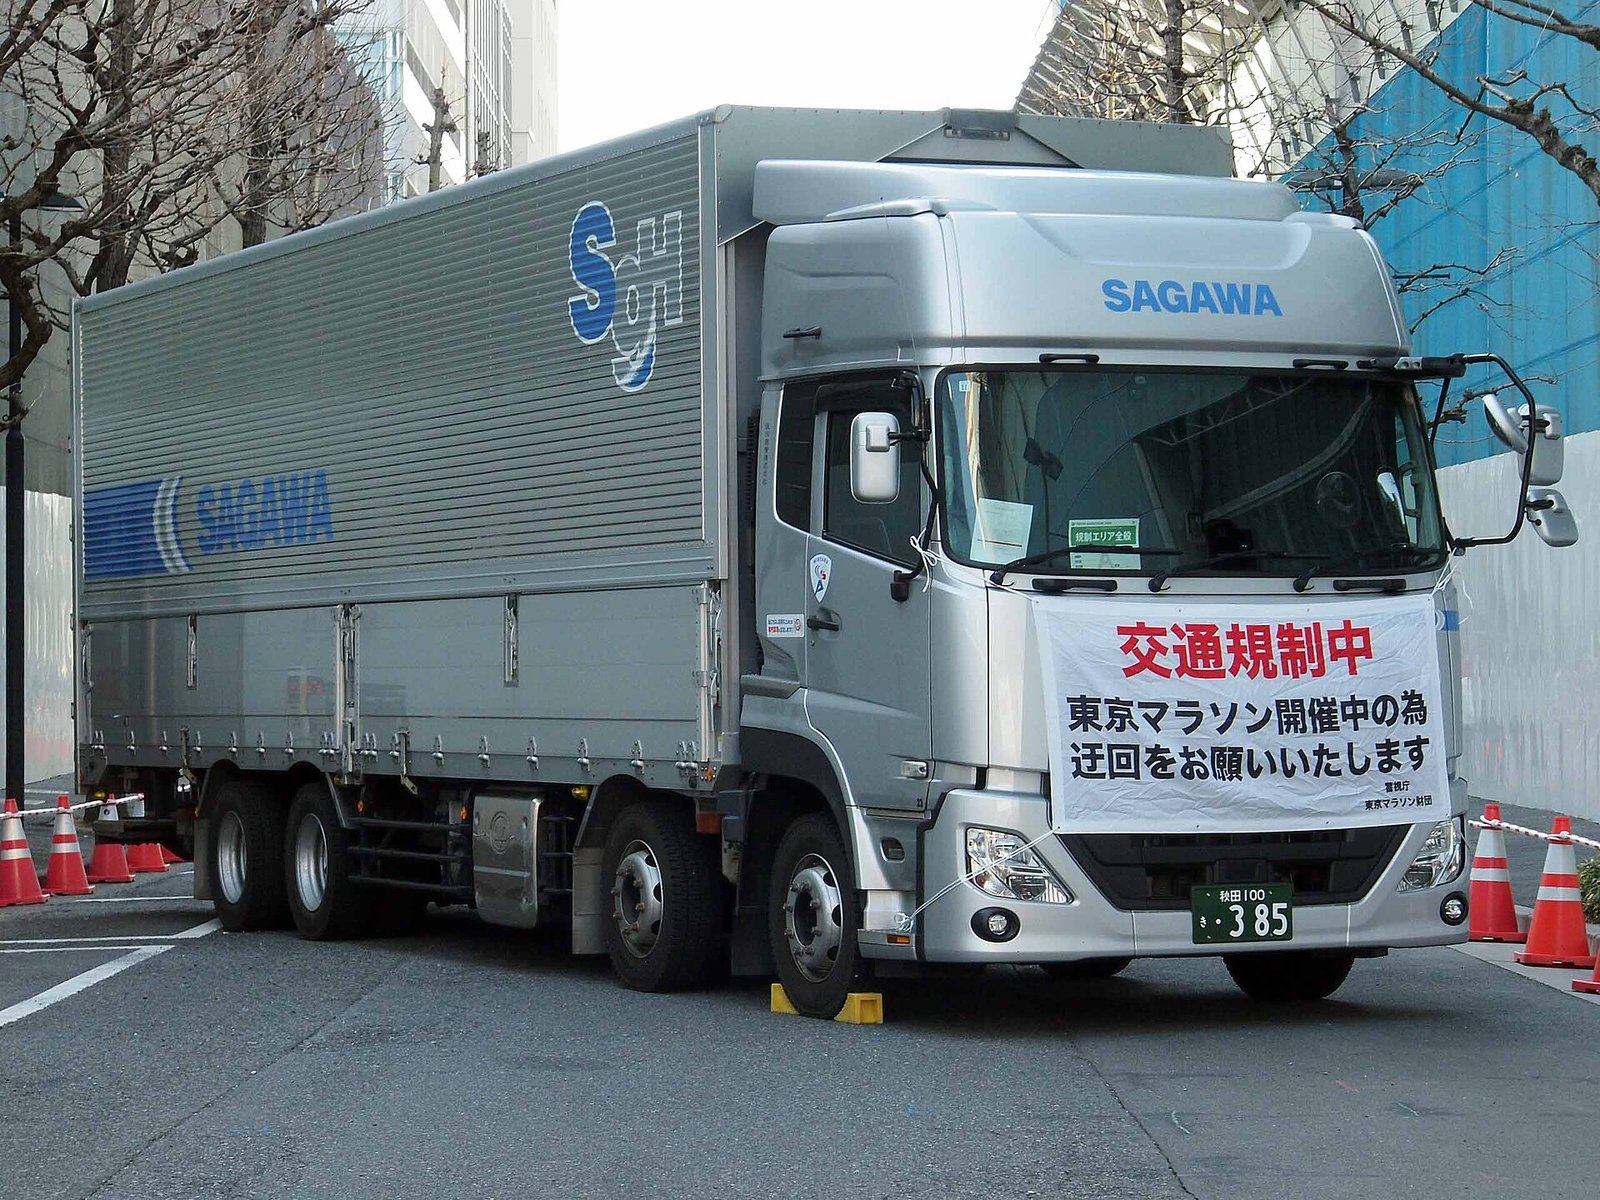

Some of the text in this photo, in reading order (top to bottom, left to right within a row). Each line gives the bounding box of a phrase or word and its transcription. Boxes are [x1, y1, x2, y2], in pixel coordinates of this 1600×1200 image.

[1101, 278, 1283, 317] SAGAWA
[196, 468, 335, 555] SAGAWA
[1116, 619, 1374, 680] 交通規制中
[1066, 689, 1427, 735] 東京マラソン開催中の為
[1070, 735, 1430, 782] 迂回をお願いいたします
[1364, 795, 1433, 811] 東京マラソン財団
[1384, 780, 1411, 793] 警視庁
[1244, 889, 1266, 902] 100
